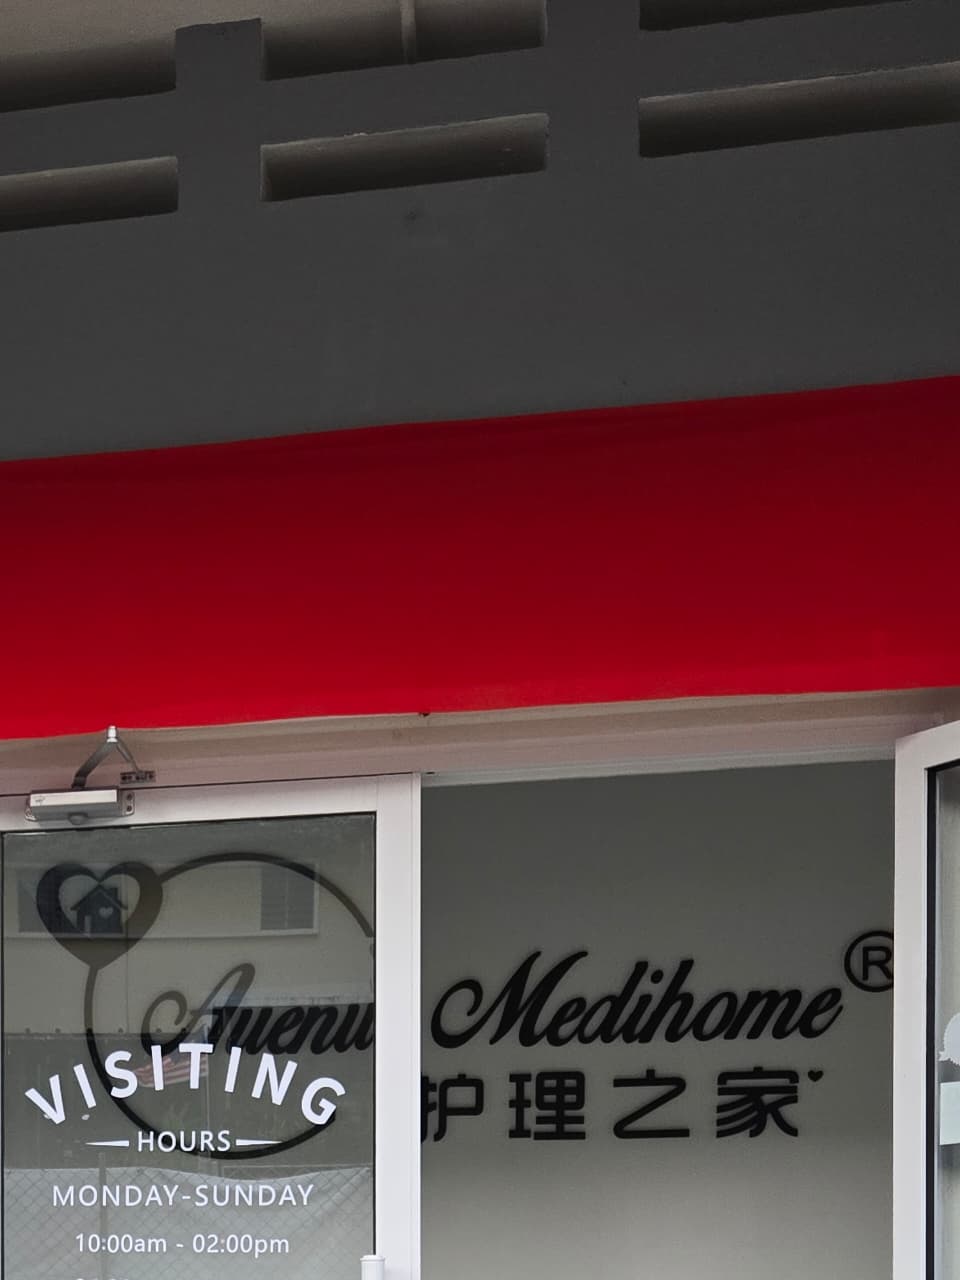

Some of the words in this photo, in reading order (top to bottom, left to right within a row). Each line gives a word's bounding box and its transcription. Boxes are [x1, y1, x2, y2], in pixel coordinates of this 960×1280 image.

[431, 950, 843, 1049] Medihome
[25, 1043, 346, 1125] VISITING
[420, 1066, 799, 1144] 护理之家
[137, 1130, 231, 1152] HOURS
[52, 1184, 314, 1207] MONDAY-SUNDAY
[75, 1234, 167, 1253] 10:00am
[192, 1234, 290, 1258] 02:00pm
